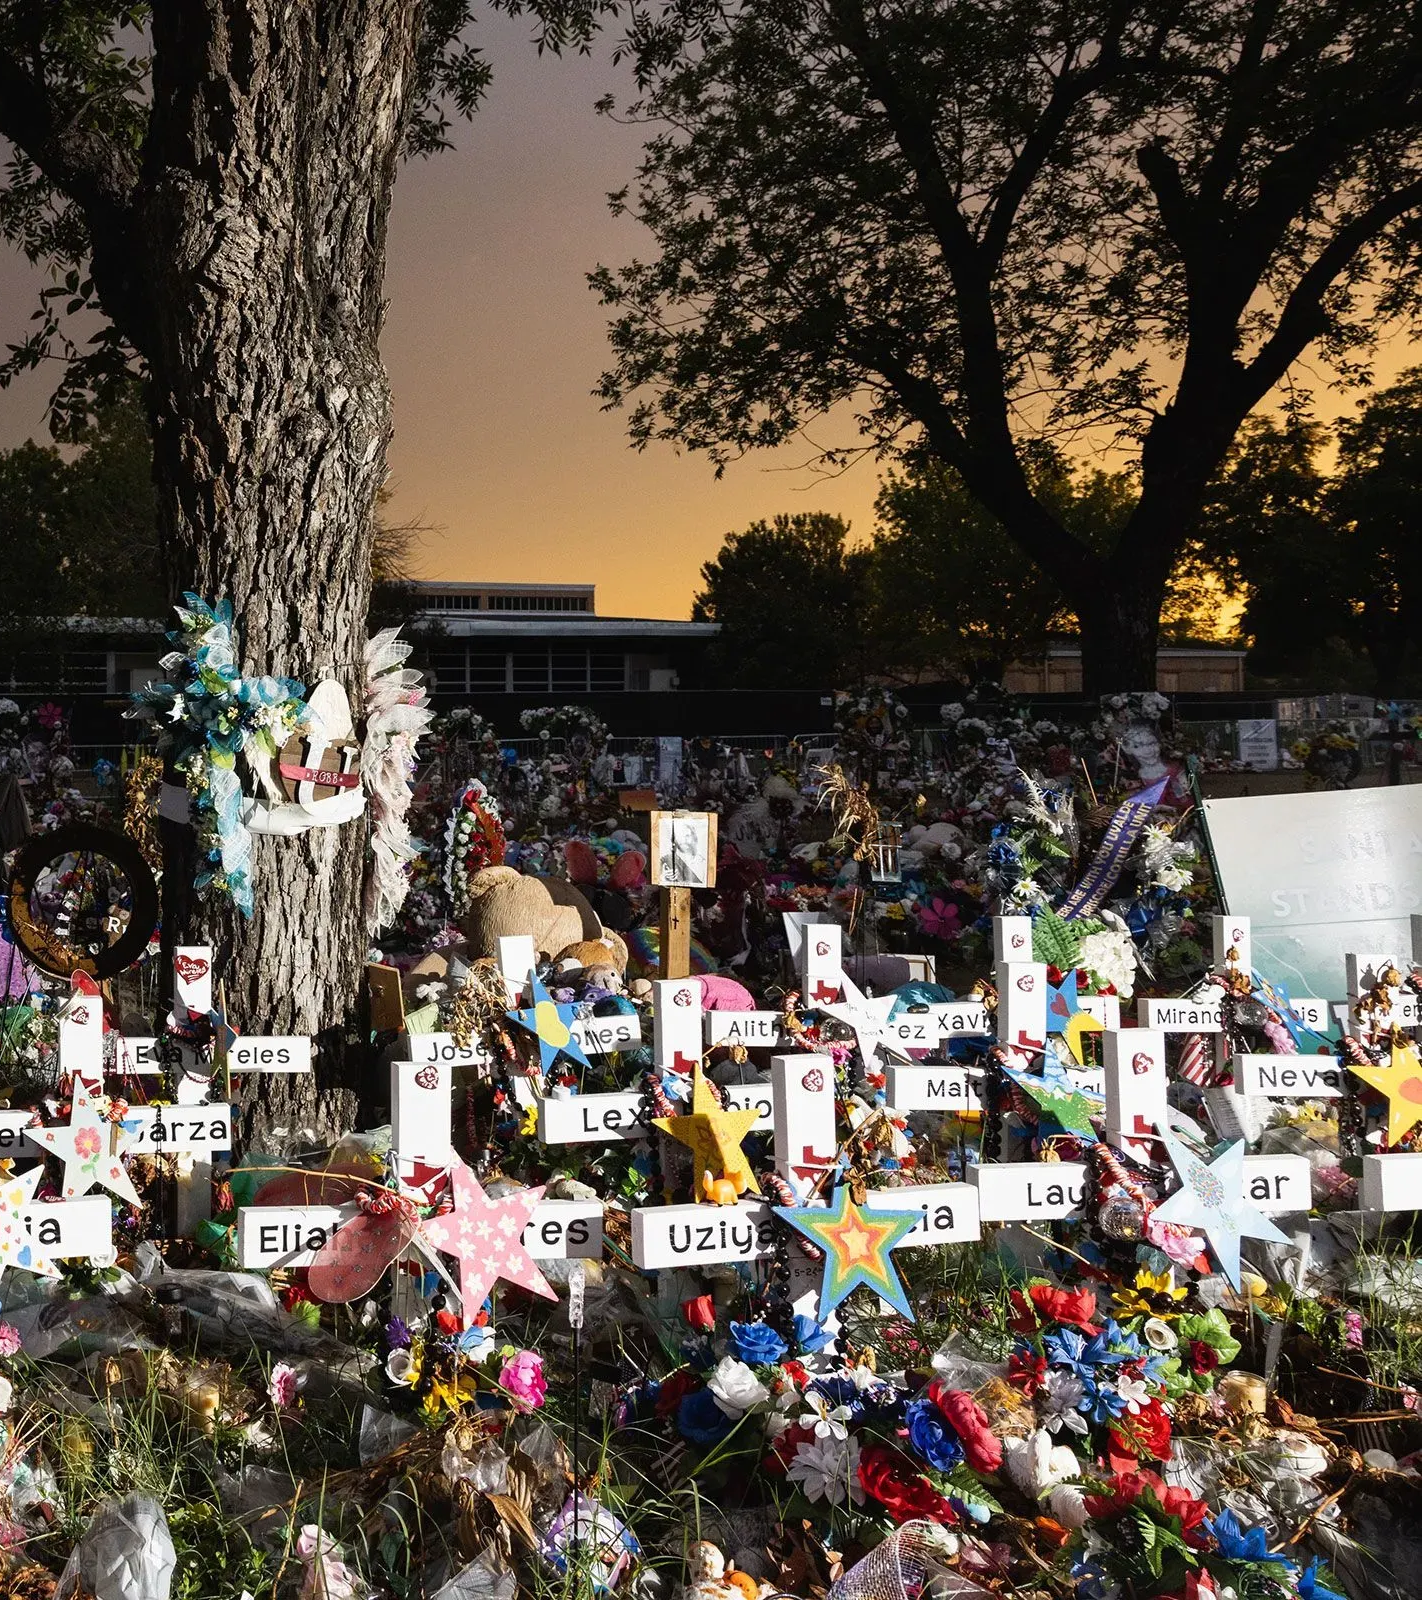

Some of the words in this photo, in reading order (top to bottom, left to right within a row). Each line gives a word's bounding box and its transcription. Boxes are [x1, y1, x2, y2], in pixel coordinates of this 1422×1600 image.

[1106, 800, 1135, 841] UVALDE
[728, 1020, 781, 1038] Alith
[938, 1009, 989, 1031] Xavi
[928, 1079, 984, 1099] Mait
[1259, 1067, 1341, 1089] Neva
[138, 1118, 229, 1143] arza
[582, 1107, 649, 1133] Lex
[1028, 1182, 1087, 1211] Lay
[669, 1219, 777, 1255] Uziya
